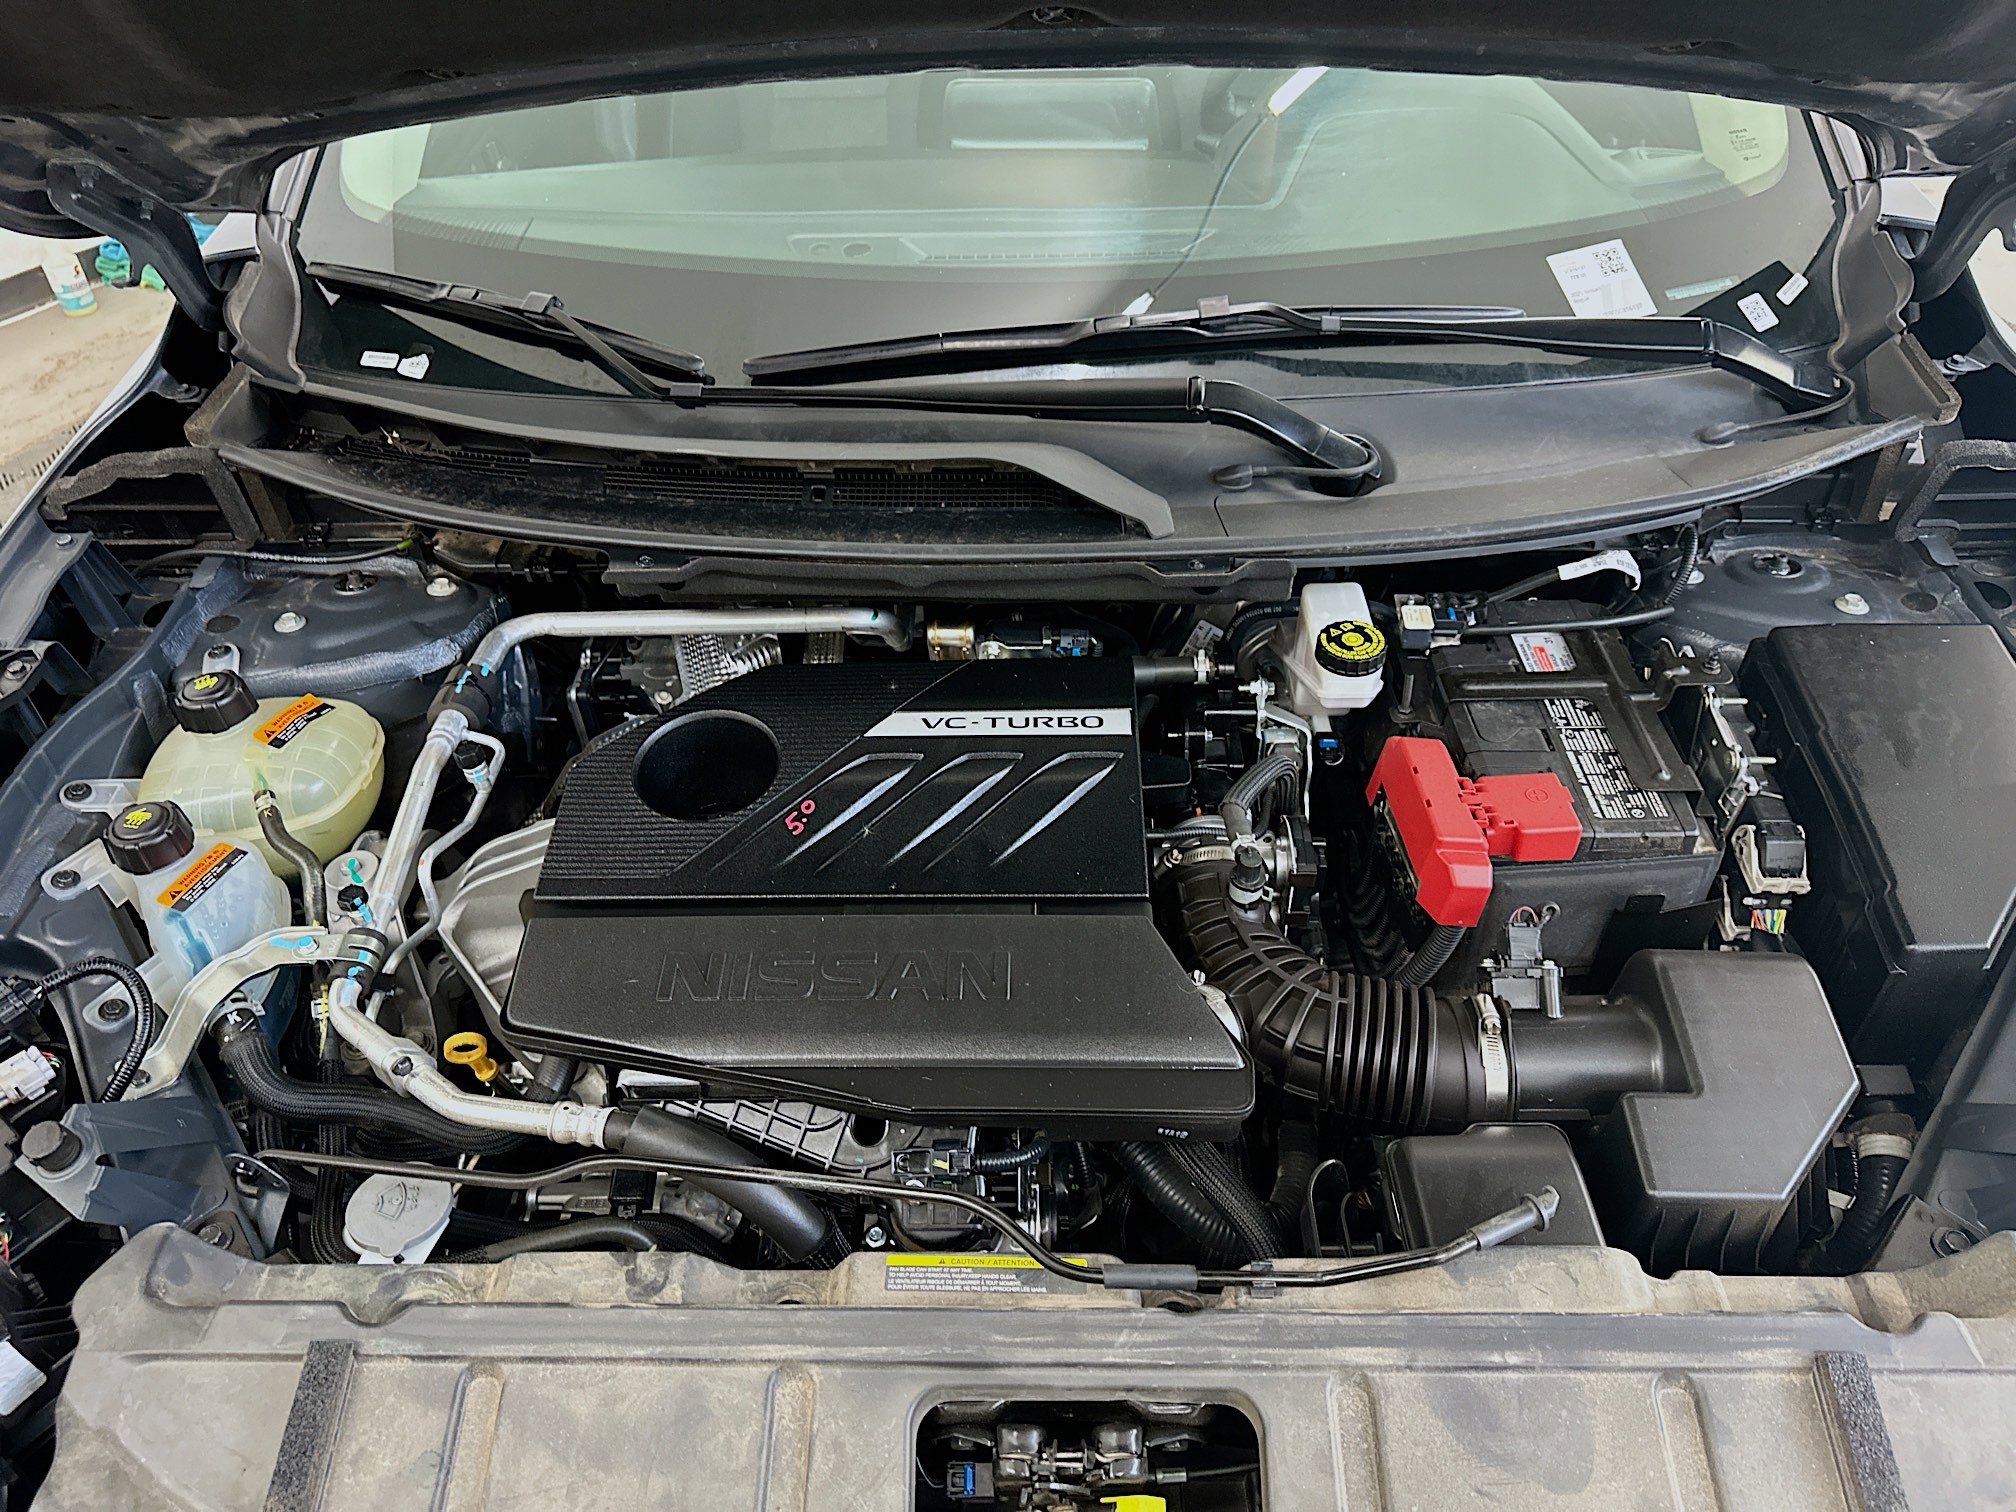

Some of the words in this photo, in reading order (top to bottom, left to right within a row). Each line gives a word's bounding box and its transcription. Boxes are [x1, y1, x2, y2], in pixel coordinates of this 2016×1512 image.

[921, 715, 1105, 729] VC-TURBO
[263, 808, 273, 818] K
[655, 949, 1013, 1002] NISSAN
[226, 1010, 243, 1025] K
